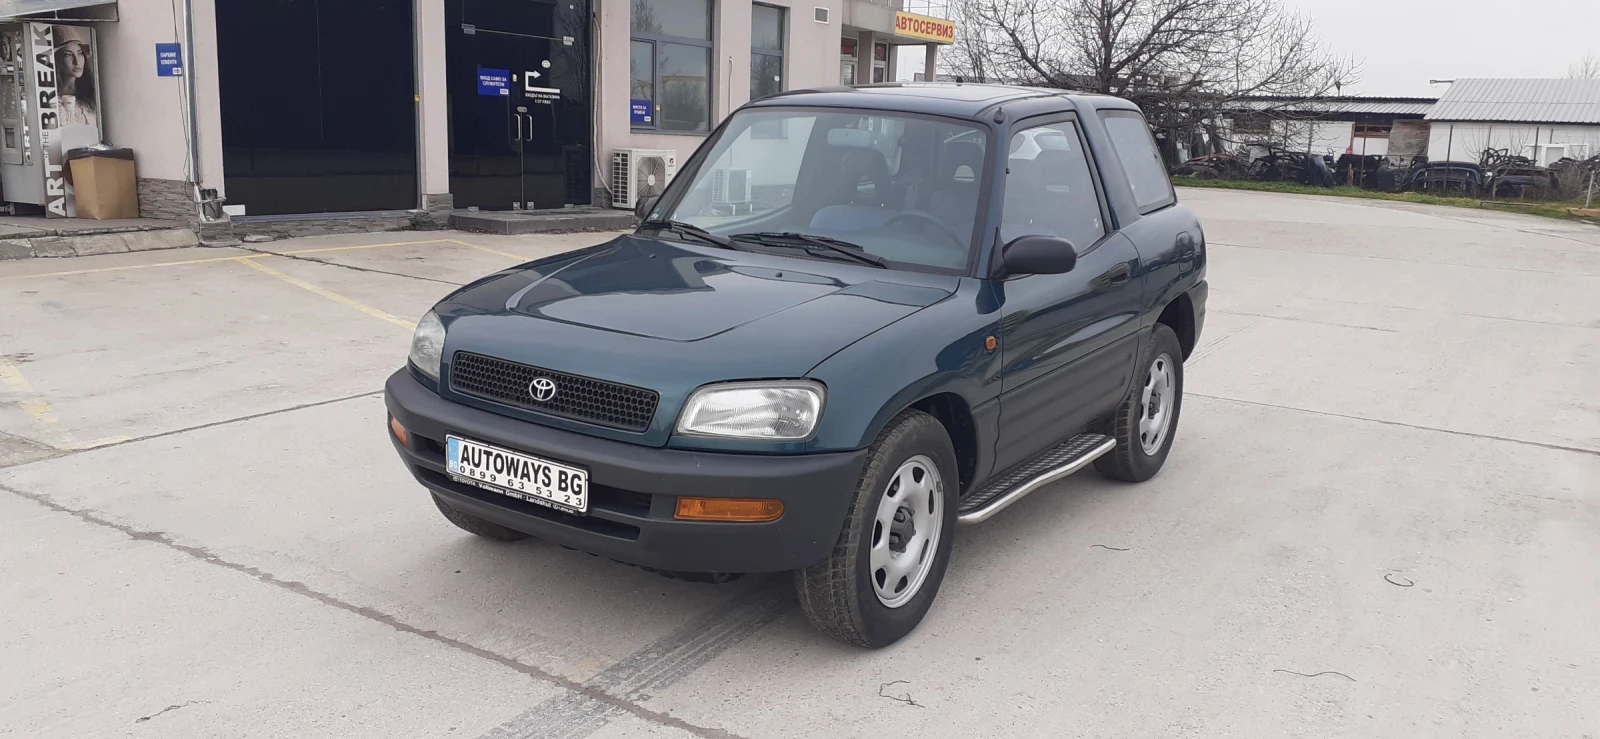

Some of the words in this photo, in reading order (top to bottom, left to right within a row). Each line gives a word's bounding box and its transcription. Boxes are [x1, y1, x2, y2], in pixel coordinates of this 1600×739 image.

[895, 15, 954, 39] АВТОСЕРВИЗ
[33, 25, 59, 130] BREAK
[41, 131, 50, 149] THE
[44, 158, 66, 217] ART
[460, 444, 552, 488] AUTOWAYS
[557, 469, 583, 496] BG
[505, 490, 522, 499] GmbH
